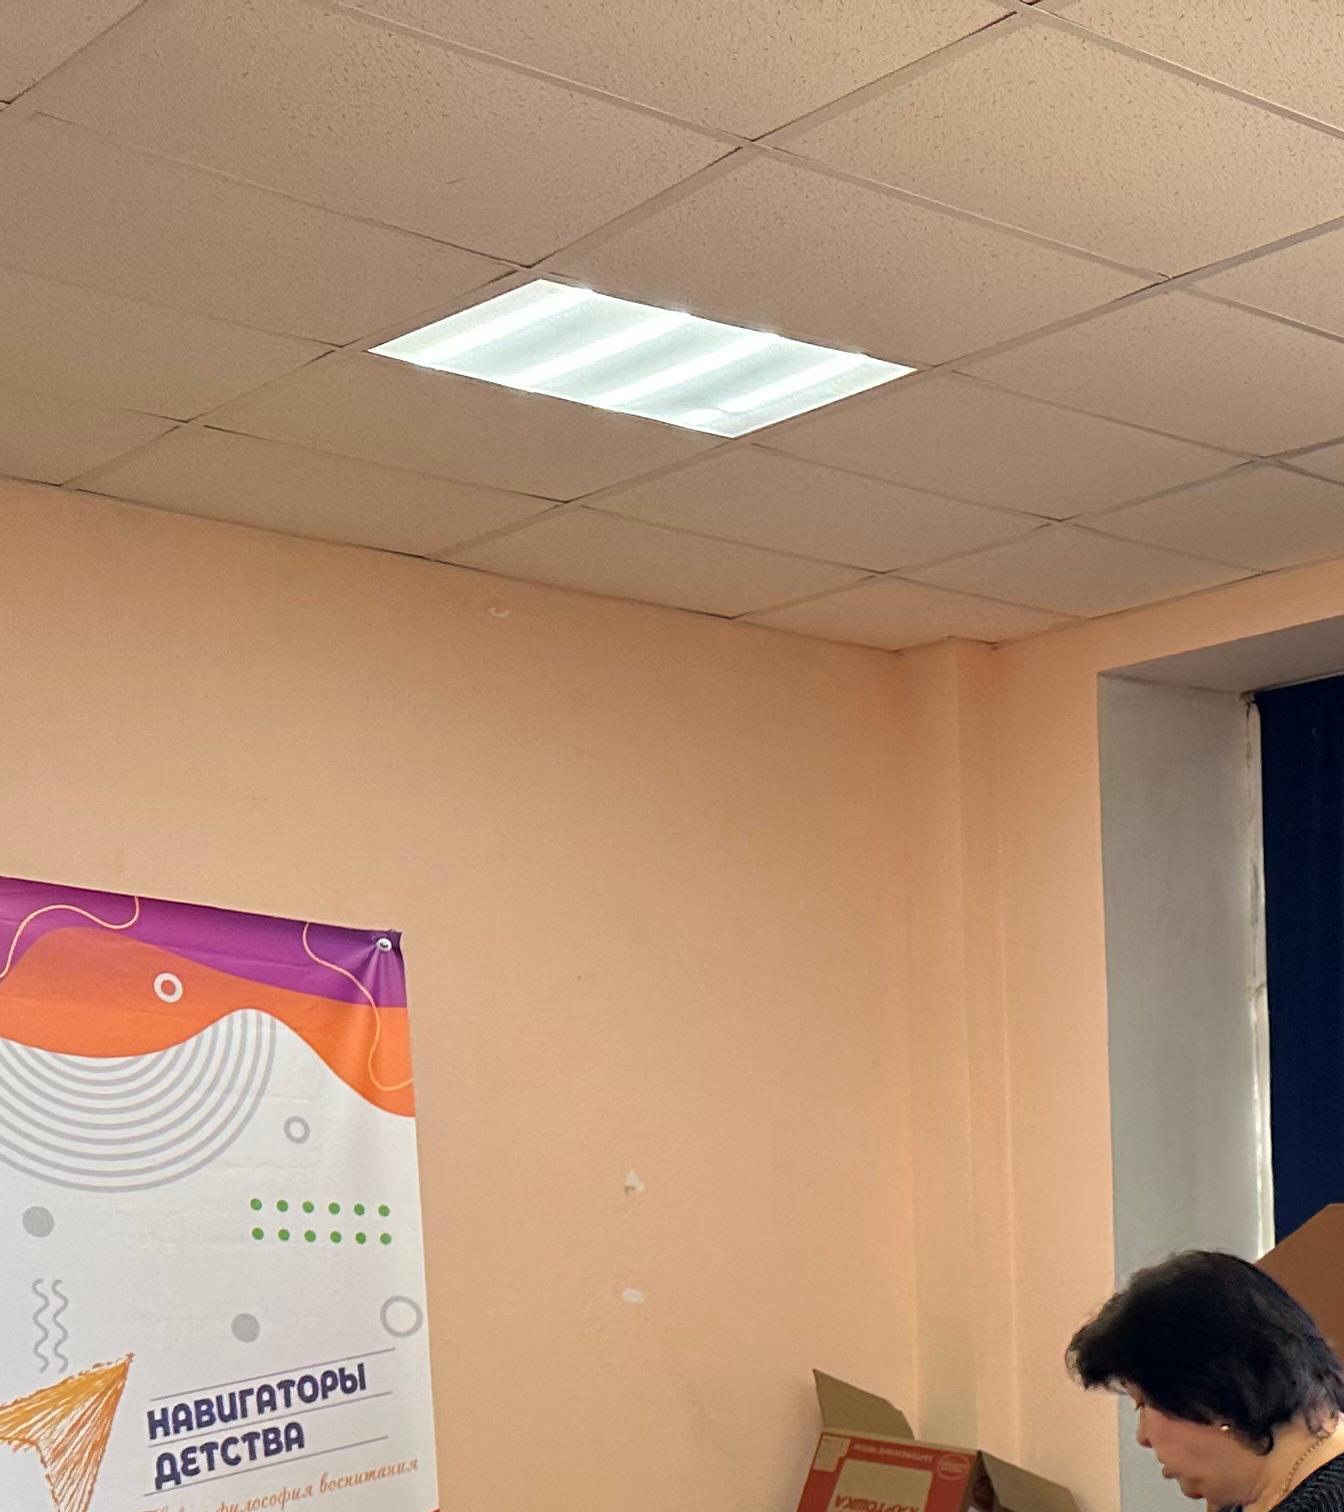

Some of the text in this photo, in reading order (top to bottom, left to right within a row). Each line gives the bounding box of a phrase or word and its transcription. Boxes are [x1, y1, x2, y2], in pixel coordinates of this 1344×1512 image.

[146, 1362, 367, 1440] НАВИГАТОРЫ
[154, 1421, 305, 1490] ДЕТСТВА
[319, 1458, 418, 1494] воспитания
